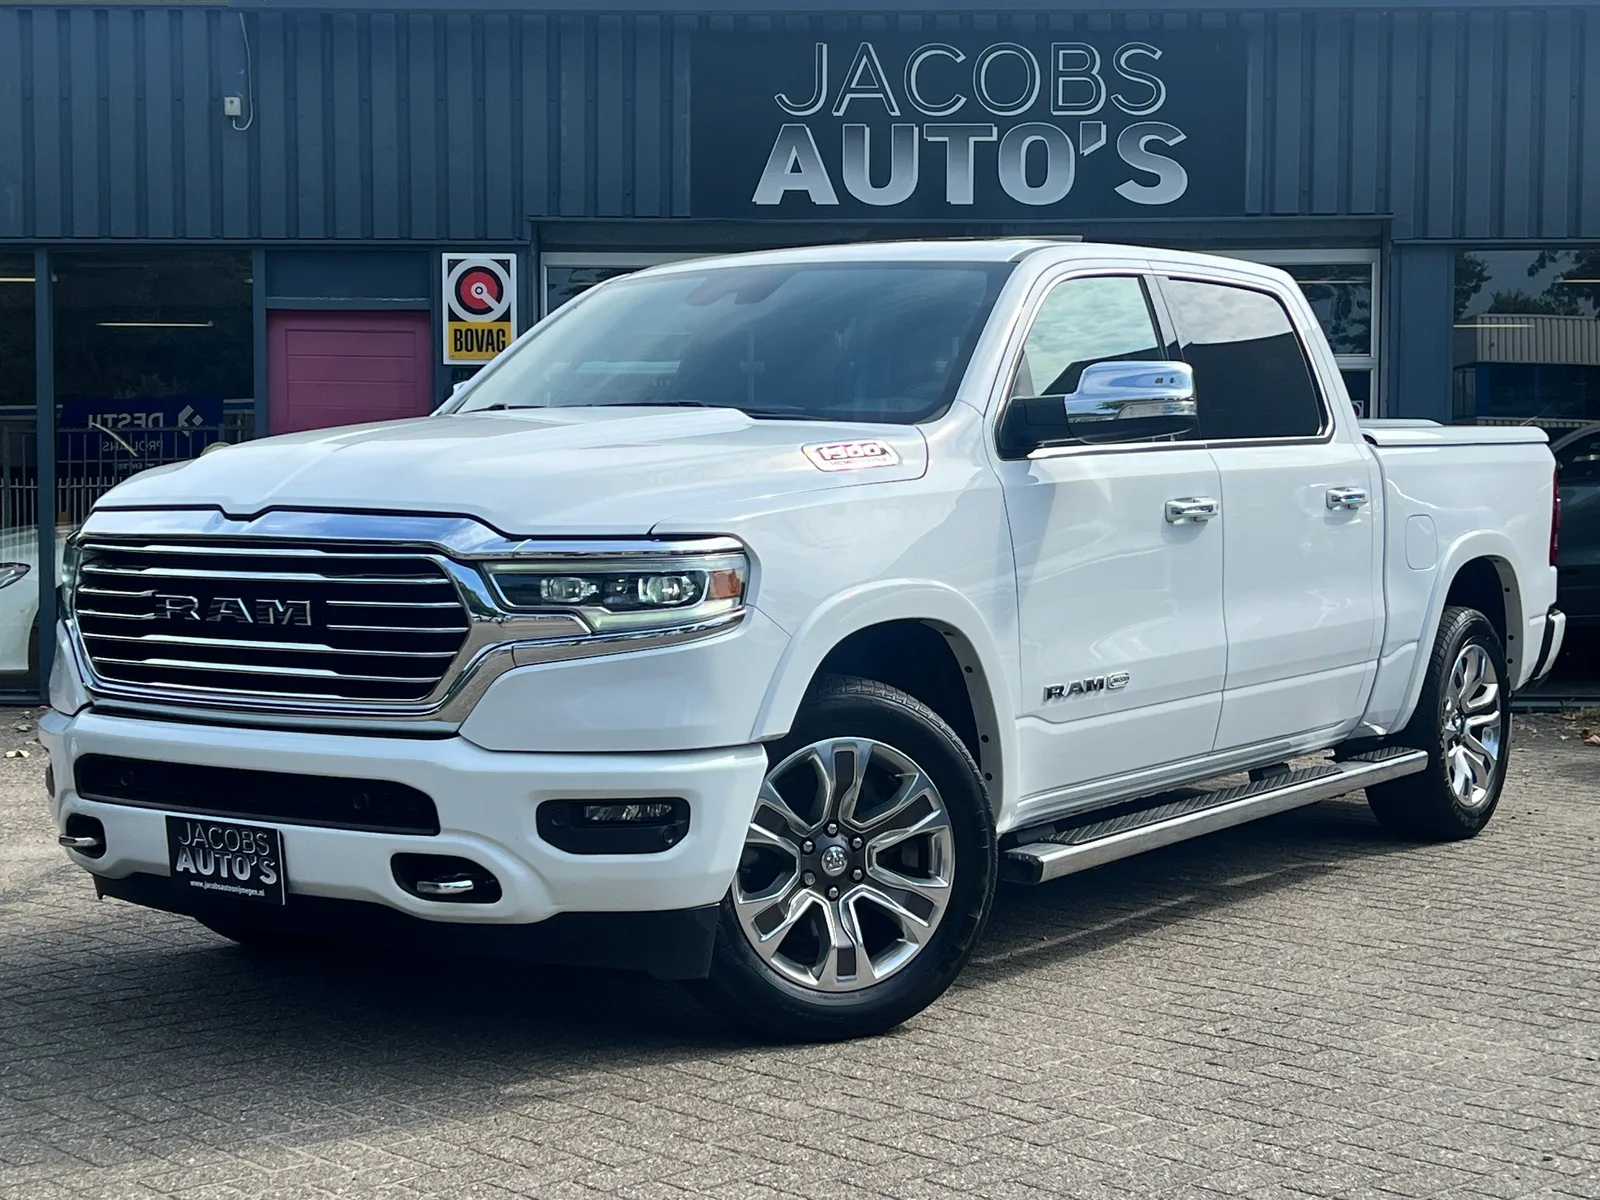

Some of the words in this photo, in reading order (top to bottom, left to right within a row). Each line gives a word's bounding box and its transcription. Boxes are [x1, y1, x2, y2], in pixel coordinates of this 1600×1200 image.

[773, 41, 1167, 118] JACOBS
[751, 121, 1189, 206] AUTO'S
[453, 328, 506, 353] BOVAG
[816, 442, 886, 461] 1500
[155, 594, 312, 626] RAM
[1043, 675, 1105, 702] RAM
[179, 822, 270, 855] JACOBS
[176, 847, 277, 884] AUTO'S
